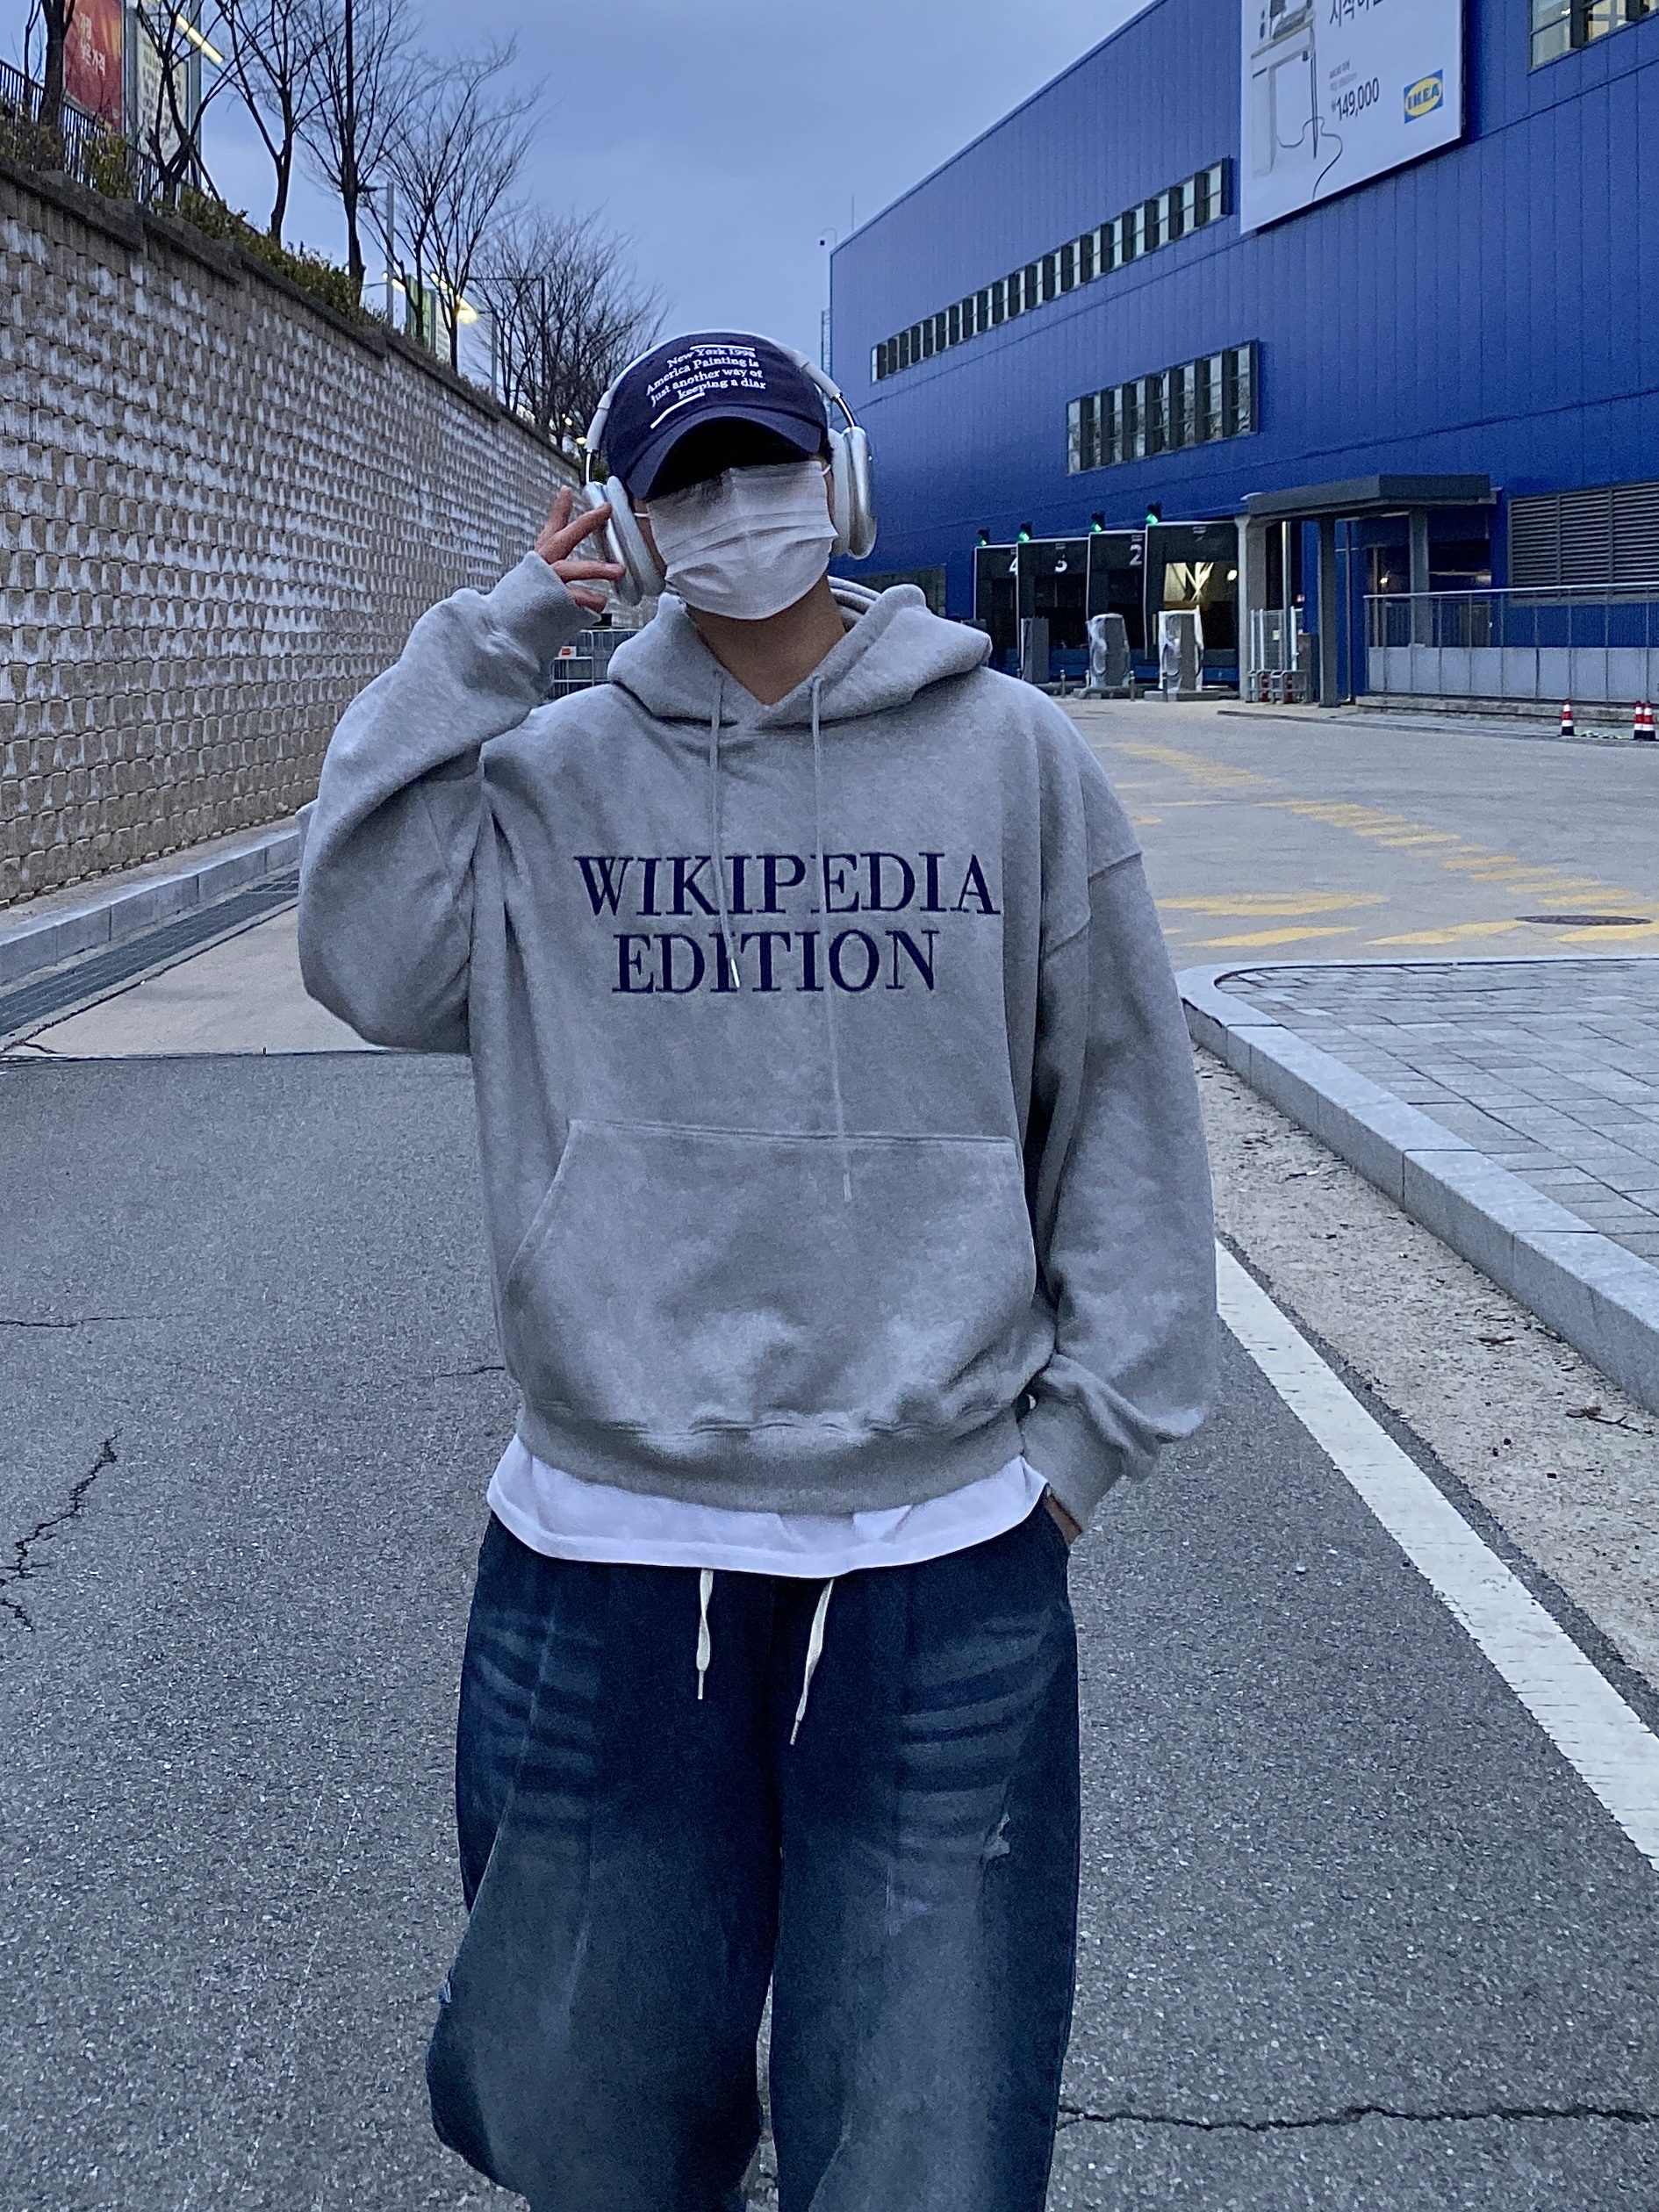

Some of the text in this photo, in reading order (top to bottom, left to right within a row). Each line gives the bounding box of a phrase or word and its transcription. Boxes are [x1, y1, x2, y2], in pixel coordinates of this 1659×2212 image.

[1407, 83, 1440, 111] IKEA
[666, 351, 694, 368] New
[694, 348, 728, 356] York
[646, 356, 759, 396] America Painting is
[672, 370, 721, 390] another
[722, 369, 747, 377] way
[750, 370, 763, 378] of
[677, 379, 728, 399] keeping
[1129, 543, 1143, 566] 2
[573, 852, 1002, 916] WIKIPEDIA
[612, 929, 939, 993] EDITION
